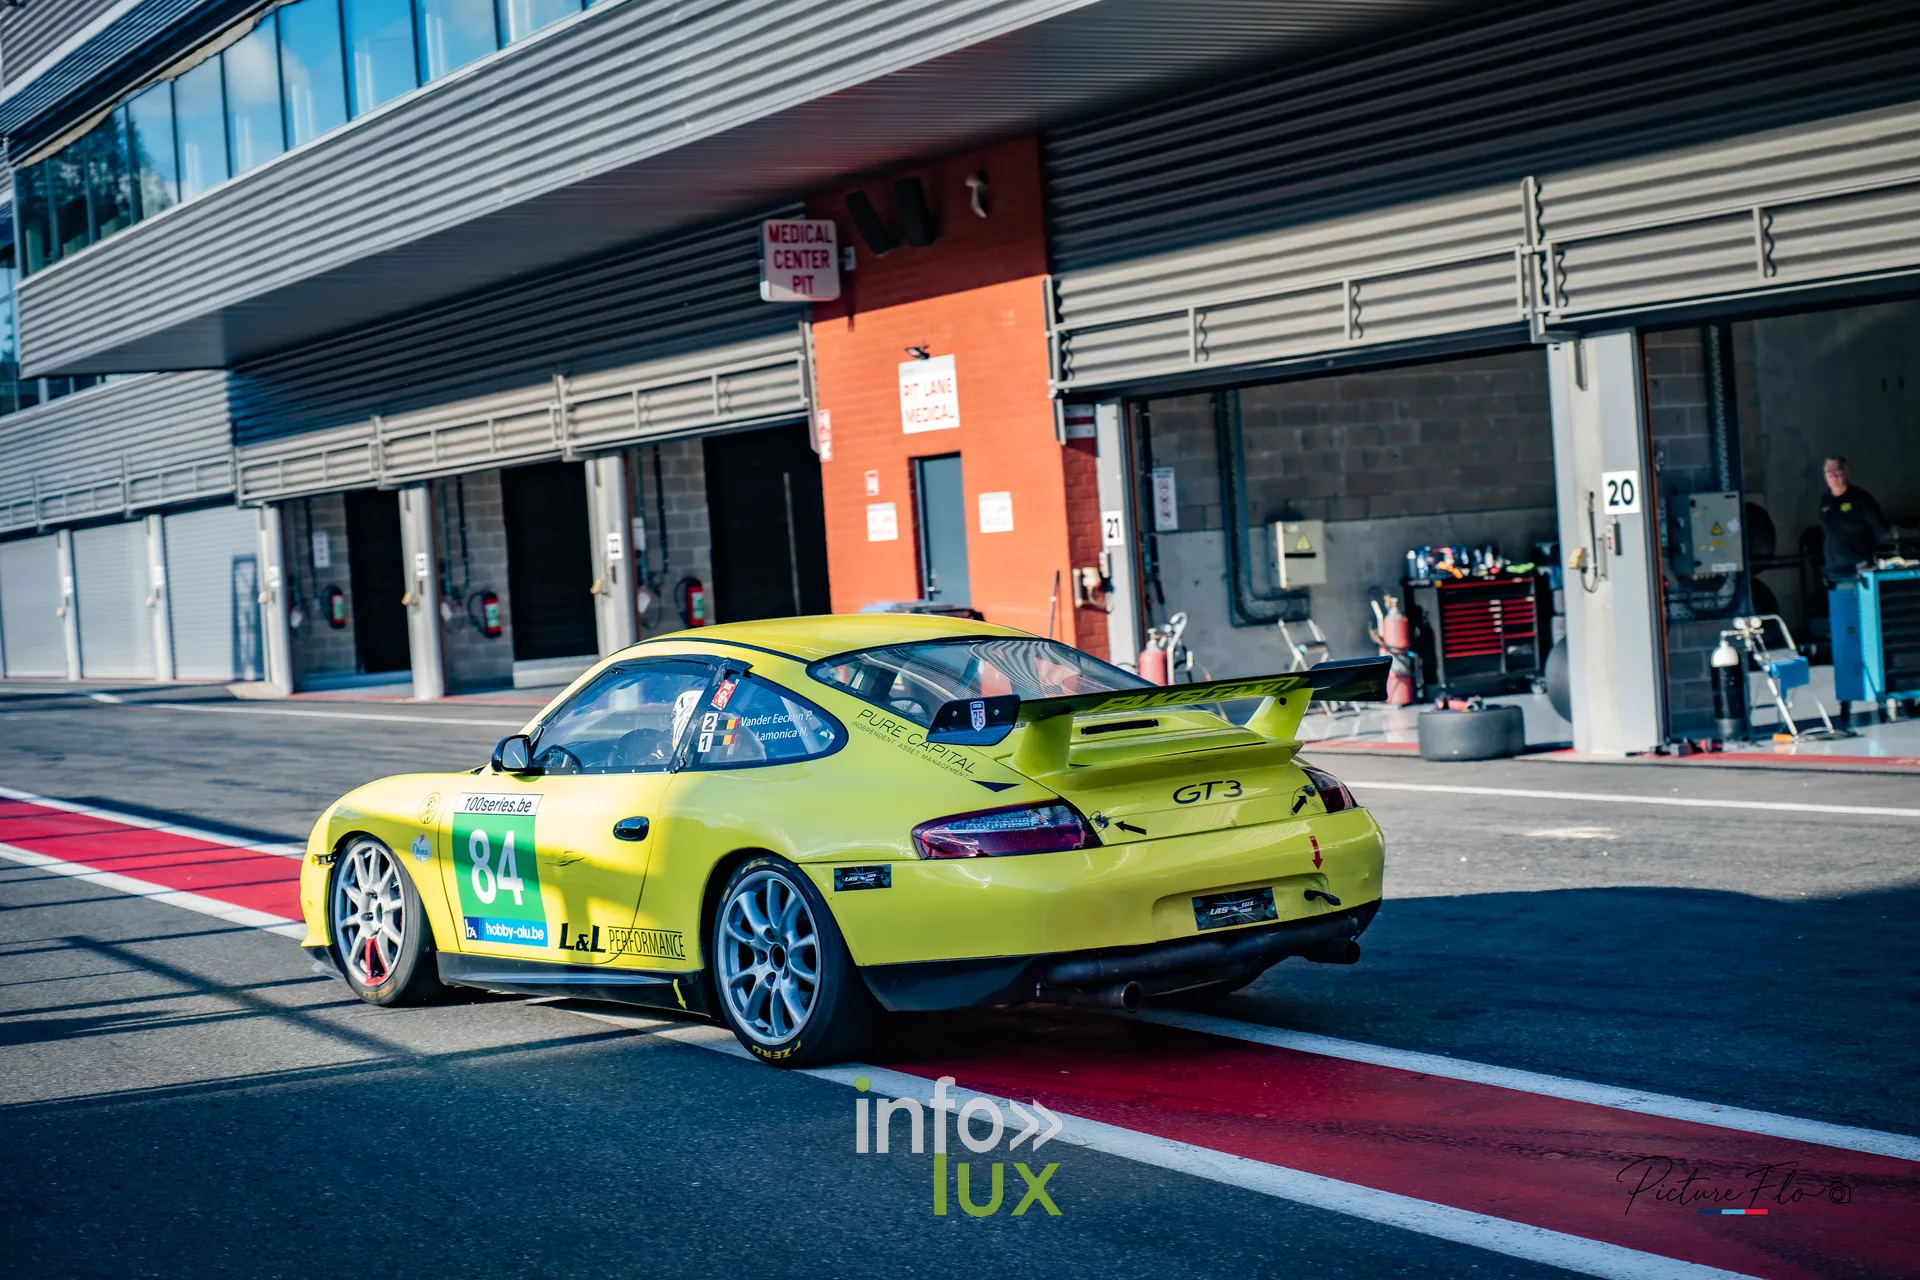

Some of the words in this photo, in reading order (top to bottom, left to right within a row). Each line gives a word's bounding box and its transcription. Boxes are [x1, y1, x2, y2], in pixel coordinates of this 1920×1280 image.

[768, 224, 833, 244] MEDICAL
[773, 249, 831, 269] CENTER
[792, 274, 815, 295] PIT
[1607, 478, 1635, 506] 20
[1106, 518, 1121, 538] 21
[704, 715, 716, 731] 2
[741, 714, 770, 727] Vander
[701, 736, 709, 751] 1
[755, 729, 797, 741] Lamonica
[852, 720, 896, 745] INDEPENDENT
[897, 743, 920, 756] ASSET
[921, 754, 970, 779] MANAGEMENT
[856, 708, 907, 738] PURE
[907, 733, 974, 774] CAPITAL
[1173, 780, 1243, 804] GT3
[464, 796, 532, 813] 100series.be
[468, 828, 525, 906] 84
[485, 922, 545, 941] hobby-alu.be
[558, 922, 607, 954] L&L
[608, 929, 687, 958] PERFORMANCE
